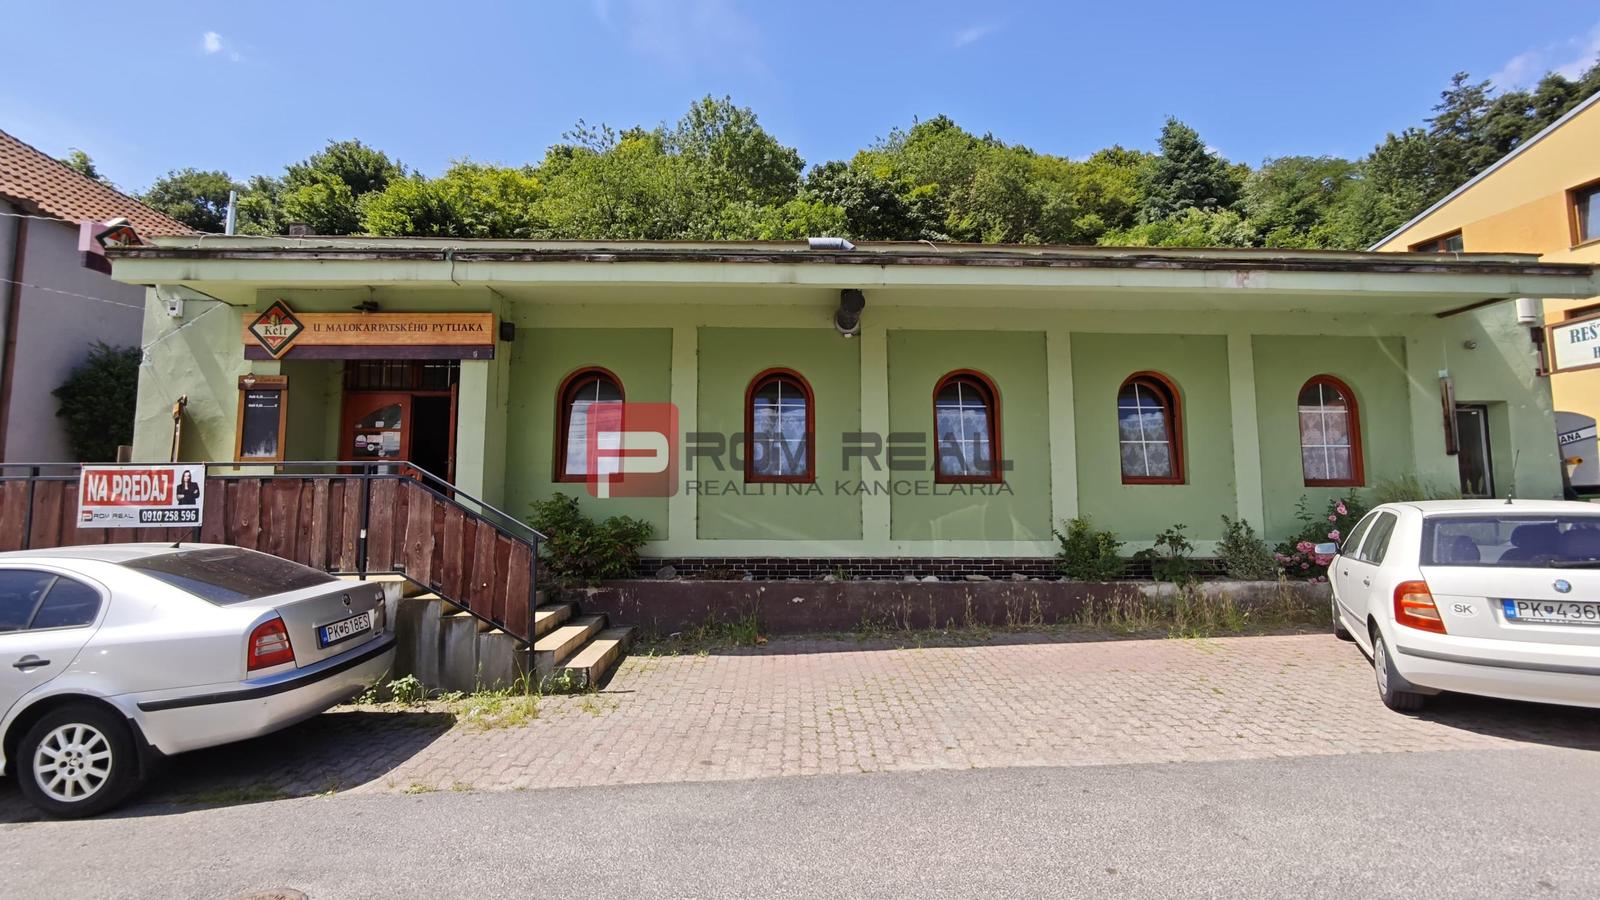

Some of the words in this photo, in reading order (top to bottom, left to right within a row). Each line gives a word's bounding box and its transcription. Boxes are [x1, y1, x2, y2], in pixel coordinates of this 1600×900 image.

[264, 325, 288, 336] Kelt
[313, 323, 321, 332] U
[325, 321, 428, 332] MALOKARPATSKÉHO
[432, 323, 483, 332] PYTLIAKA
[1570, 322, 1600, 344] REŠ
[87, 474, 108, 502] NA
[110, 474, 168, 502] PREDAJ
[142, 510, 162, 521] 0910
[164, 510, 179, 521] 258
[180, 510, 196, 521] 596
[1454, 604, 1473, 614] SK
